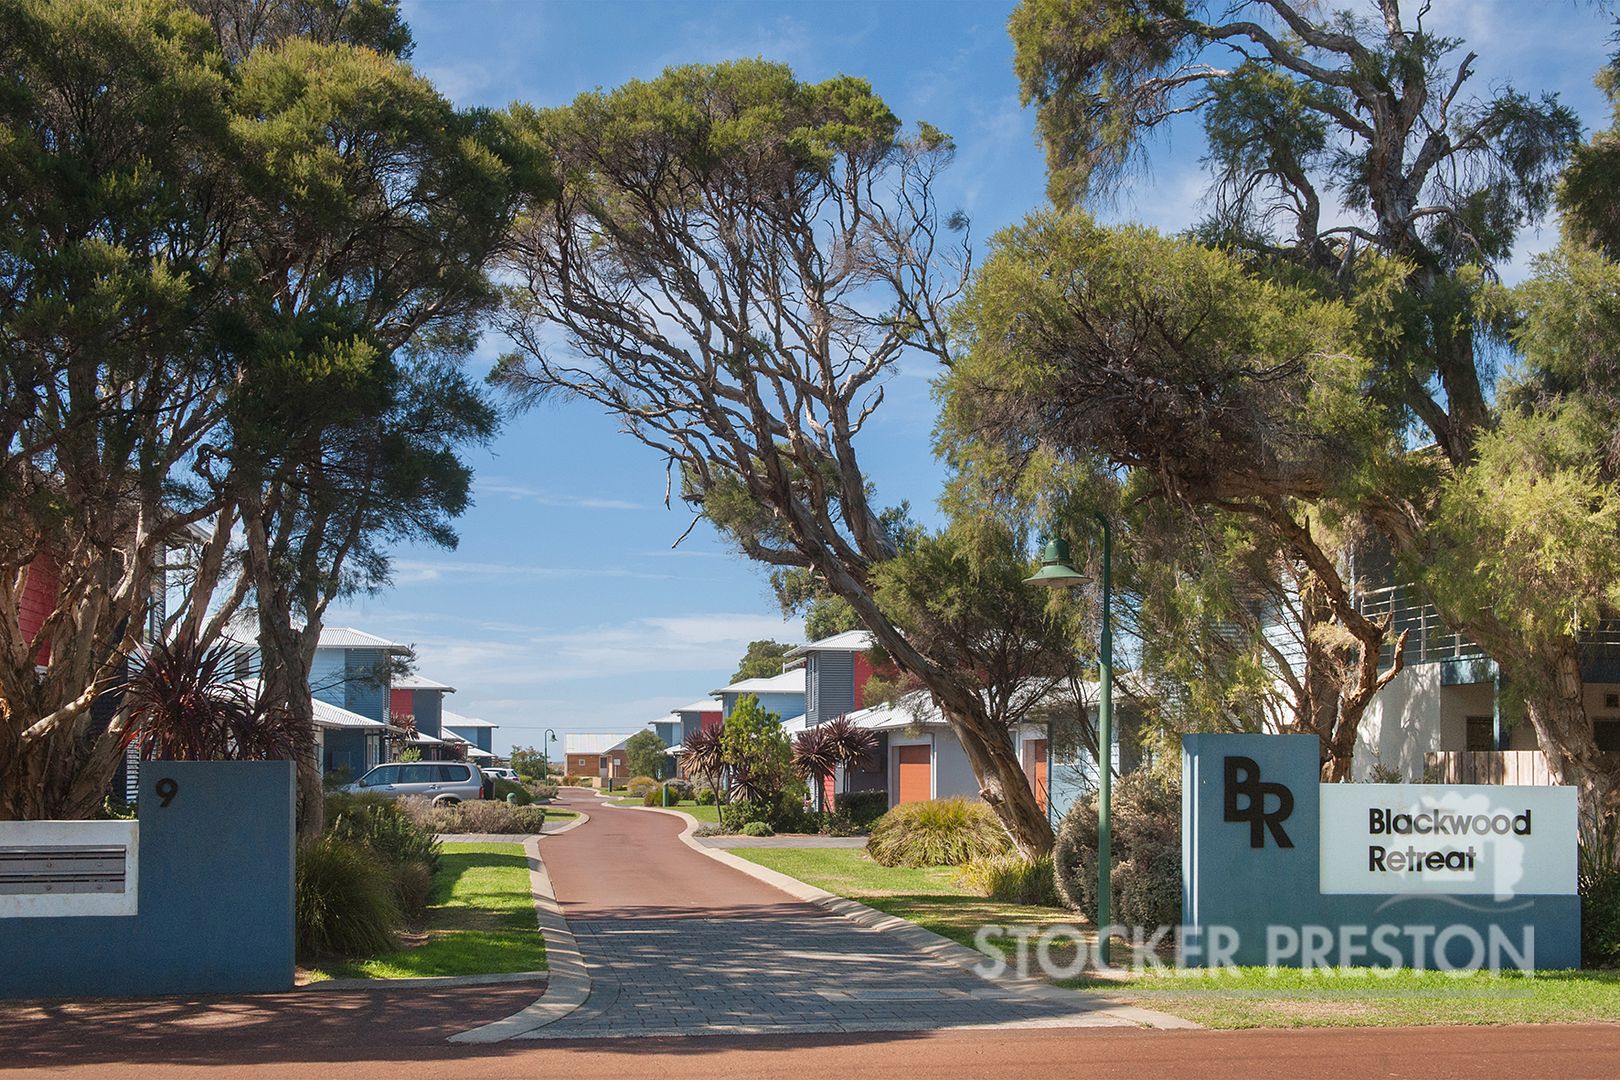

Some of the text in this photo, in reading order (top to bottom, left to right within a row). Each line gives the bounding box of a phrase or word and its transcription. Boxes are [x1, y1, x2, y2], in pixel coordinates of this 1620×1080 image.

[155, 777, 178, 807] 9
[1369, 808, 1532, 835] Blackwood
[1369, 846, 1476, 872] Retreat
